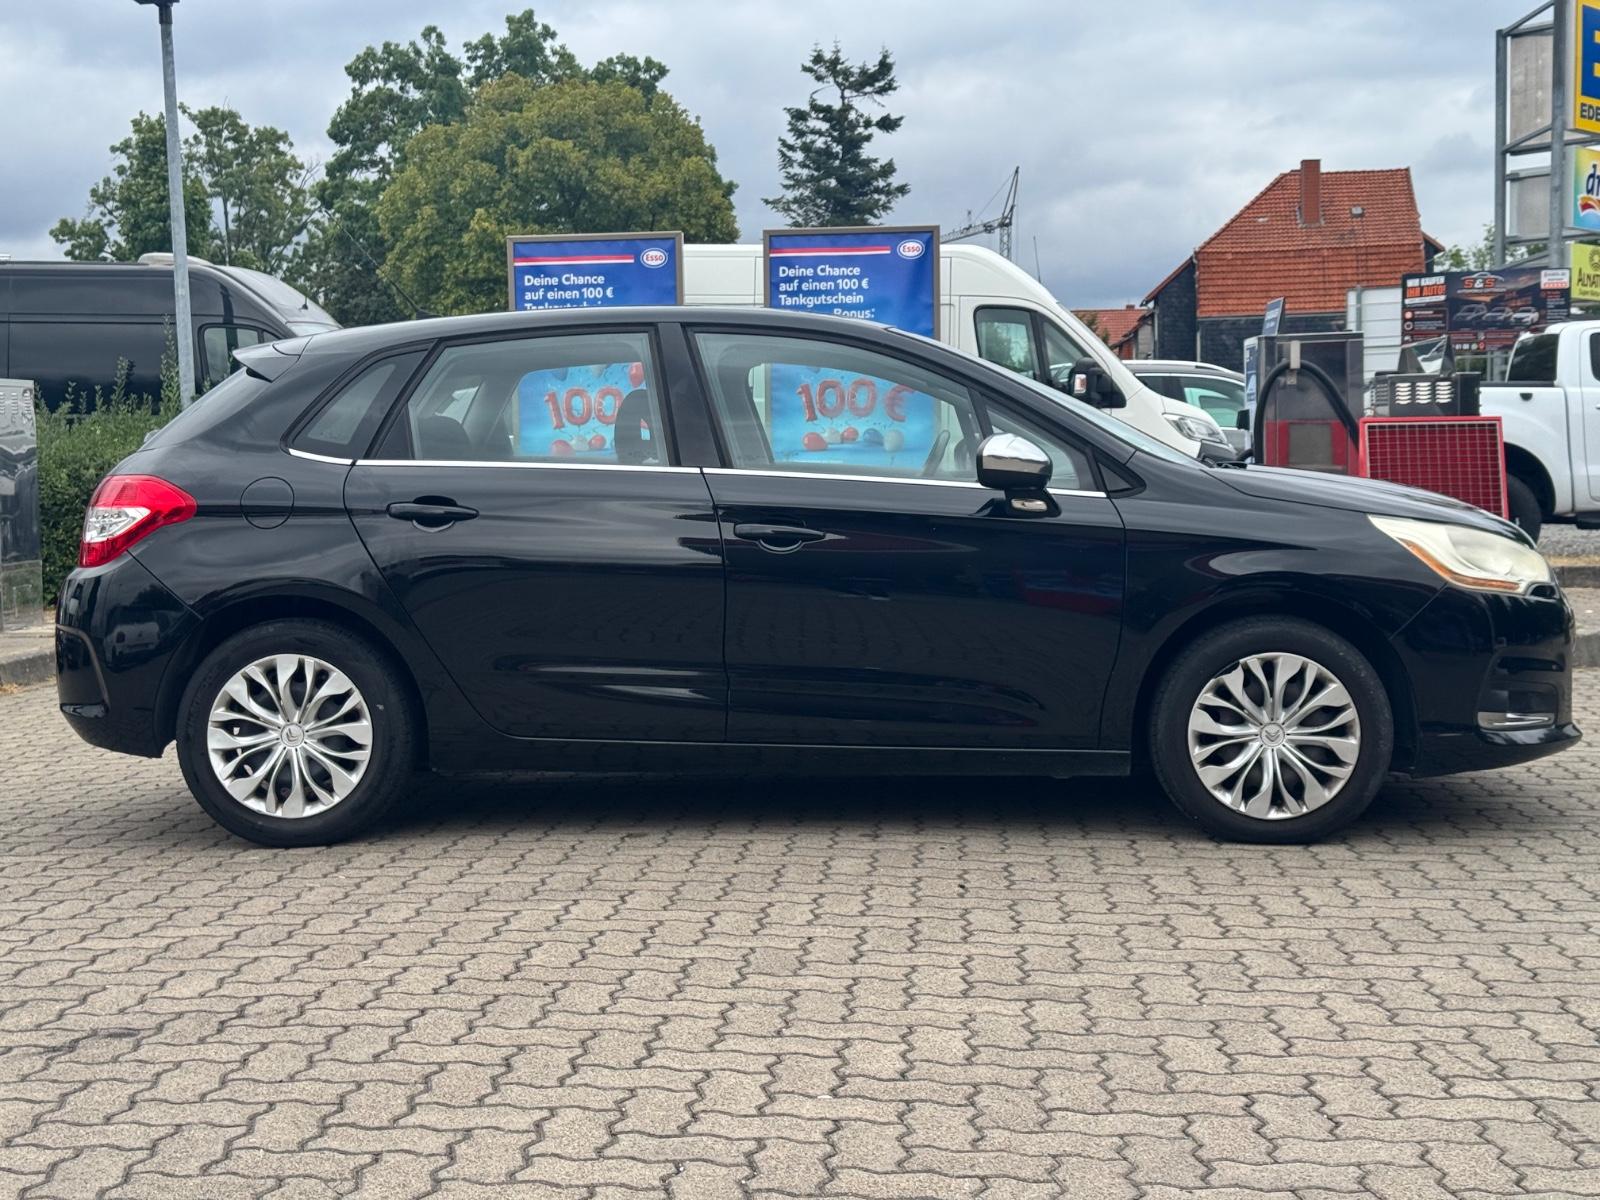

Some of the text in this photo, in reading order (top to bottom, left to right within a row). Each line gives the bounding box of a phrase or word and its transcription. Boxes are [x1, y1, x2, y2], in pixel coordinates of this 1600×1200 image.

[903, 245, 920, 253] Esso
[645, 253, 663, 262] Esso
[779, 265, 860, 277] Deine Chance
[524, 274, 605, 286] Deine Chance
[779, 278, 869, 291] auf einen 100 €
[524, 287, 614, 300] auf einen 100 €
[1407, 286, 1420, 297] IHR
[1422, 284, 1446, 296] AUTO!
[779, 294, 864, 307] Tankgutschein
[833, 309, 875, 319] Bonus:
[796, 379, 876, 422] 100
[544, 387, 624, 429] 100
